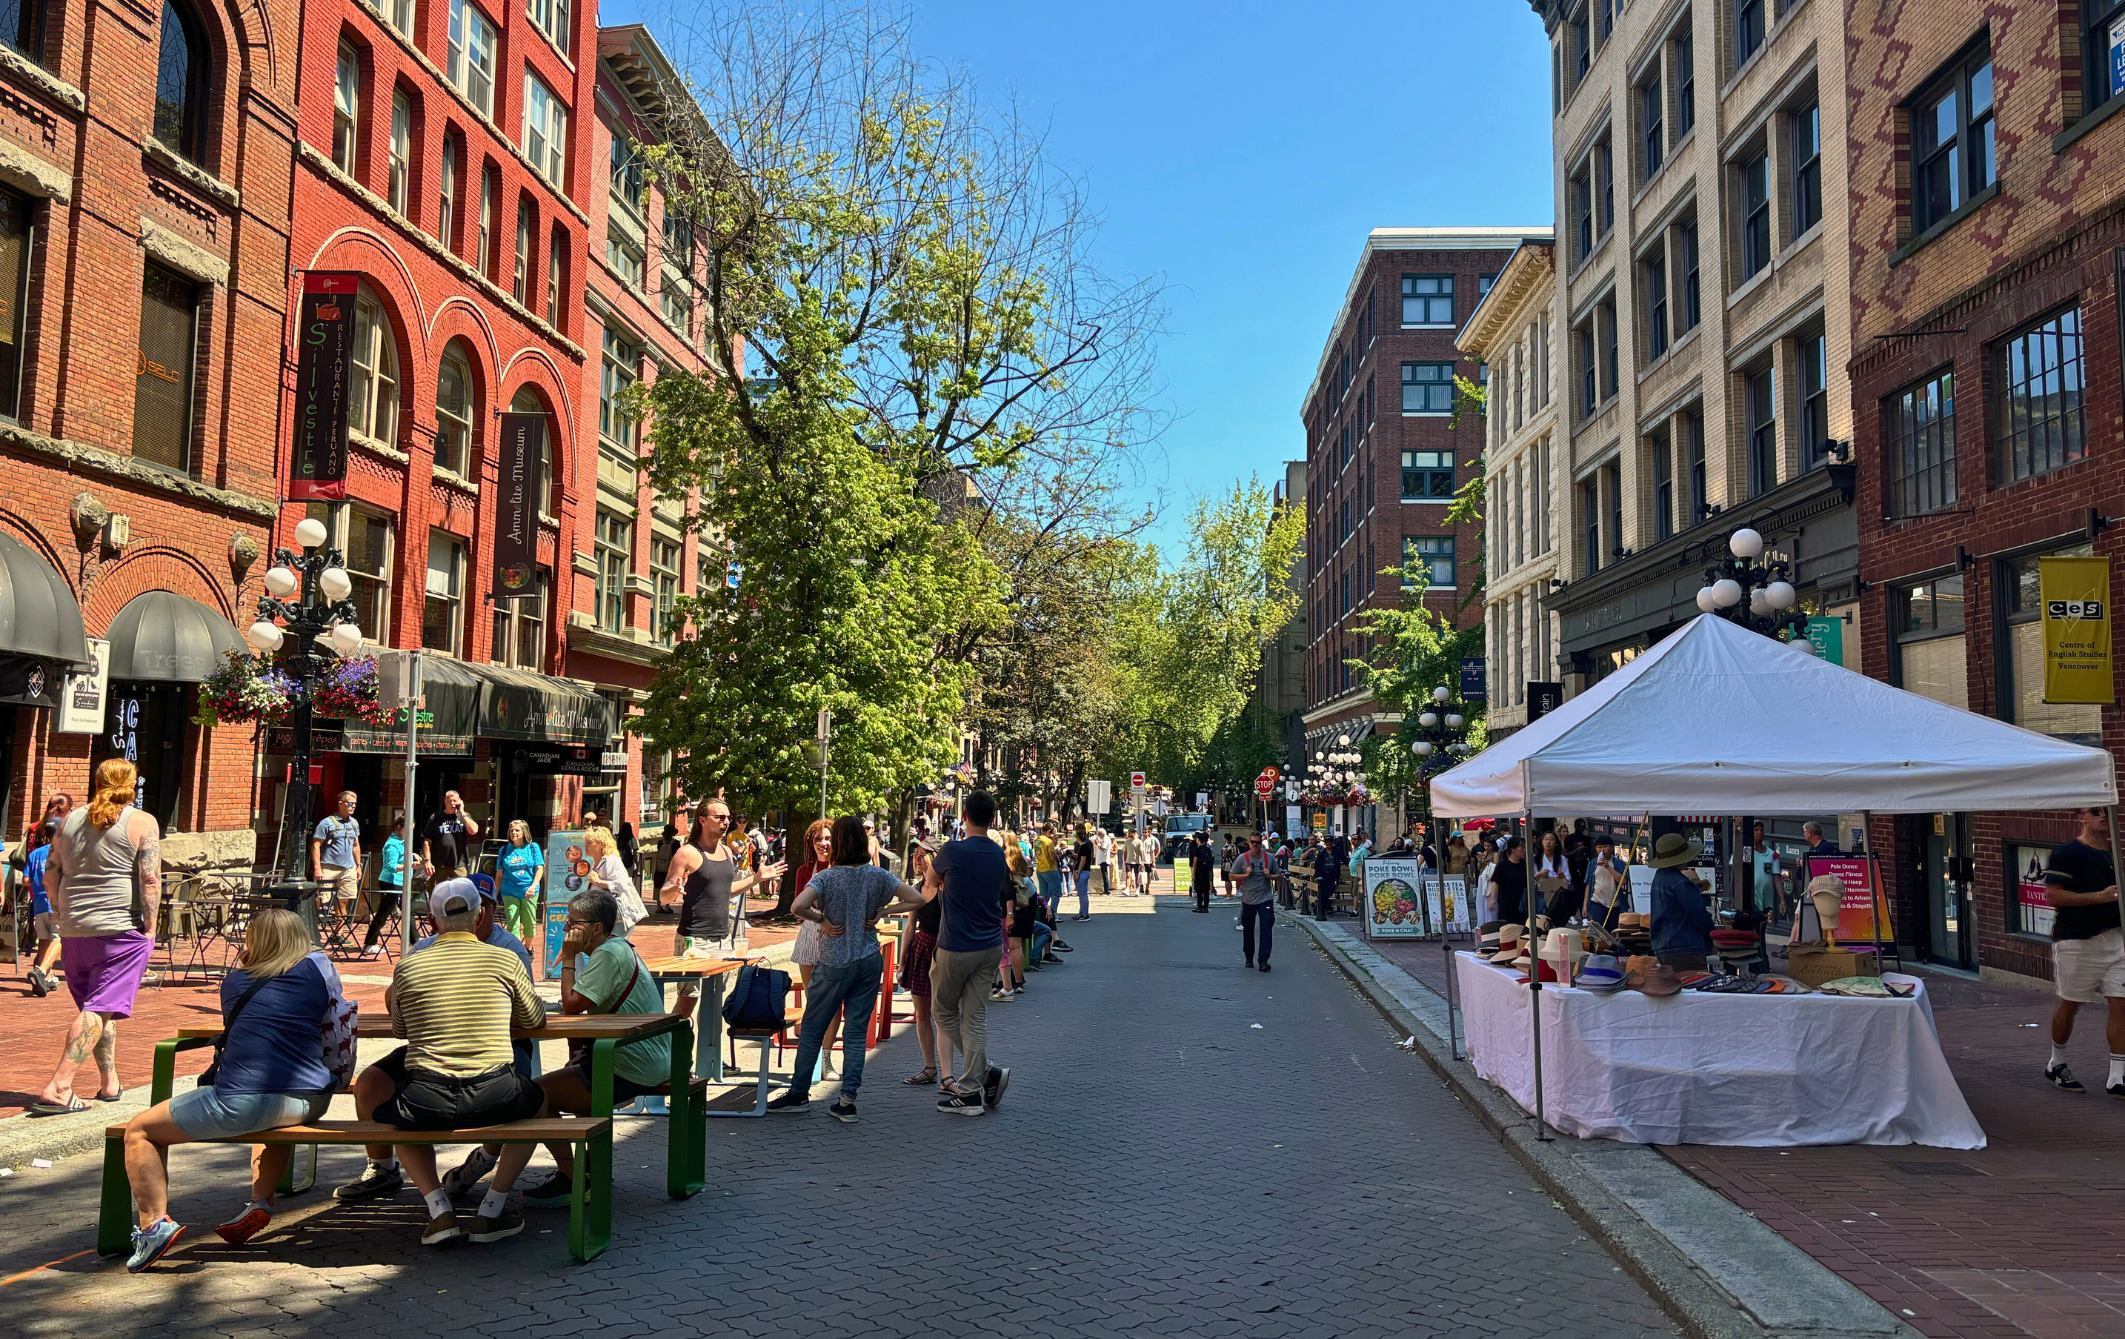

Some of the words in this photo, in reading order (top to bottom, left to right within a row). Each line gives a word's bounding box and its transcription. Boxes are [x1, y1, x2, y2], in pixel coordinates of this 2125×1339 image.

[332, 324, 343, 414] RESTAURANTE
[302, 323, 327, 474] Silvestre
[328, 421, 337, 475] PERUANO
[512, 426, 526, 482] Museum
[2049, 650, 2077, 659] English
[2079, 650, 2107, 658] Studies
[2058, 662, 2098, 670] Vancouver
[1540, 693, 1550, 715] tain
[399, 707, 434, 723] Sestre
[311, 734, 338, 747] rêpes
[1256, 780, 1272, 789] STOP
[135, 788, 144, 810] espr
[2026, 890, 2047, 900] TANTR
